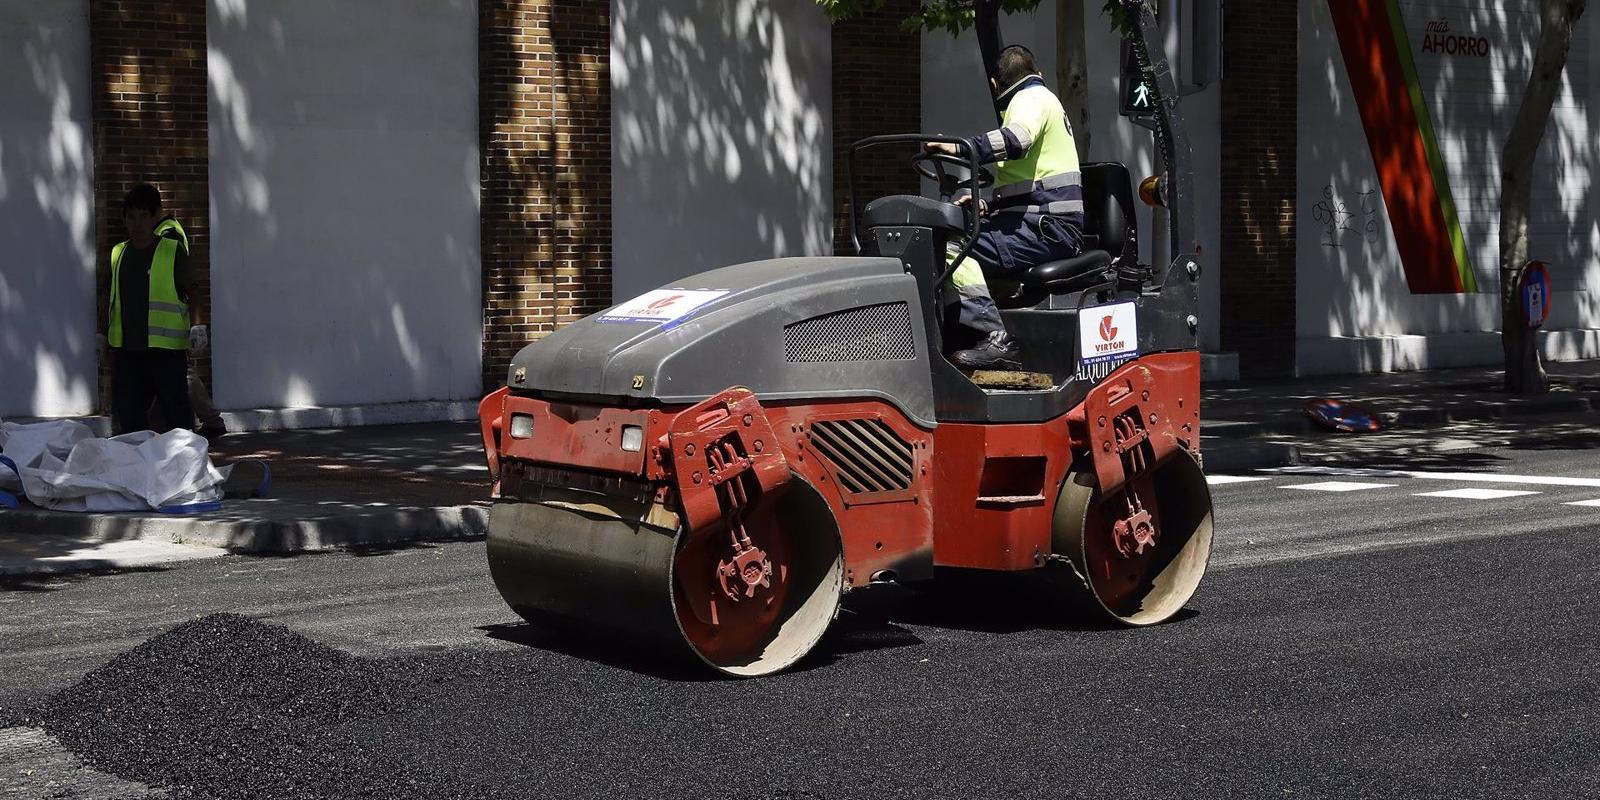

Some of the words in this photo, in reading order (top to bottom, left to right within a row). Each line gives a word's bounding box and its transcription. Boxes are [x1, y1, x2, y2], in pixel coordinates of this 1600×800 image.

[1426, 16, 1449, 33] más
[1422, 34, 1488, 57] AHORRO
[1095, 341, 1124, 352] VIRTON
